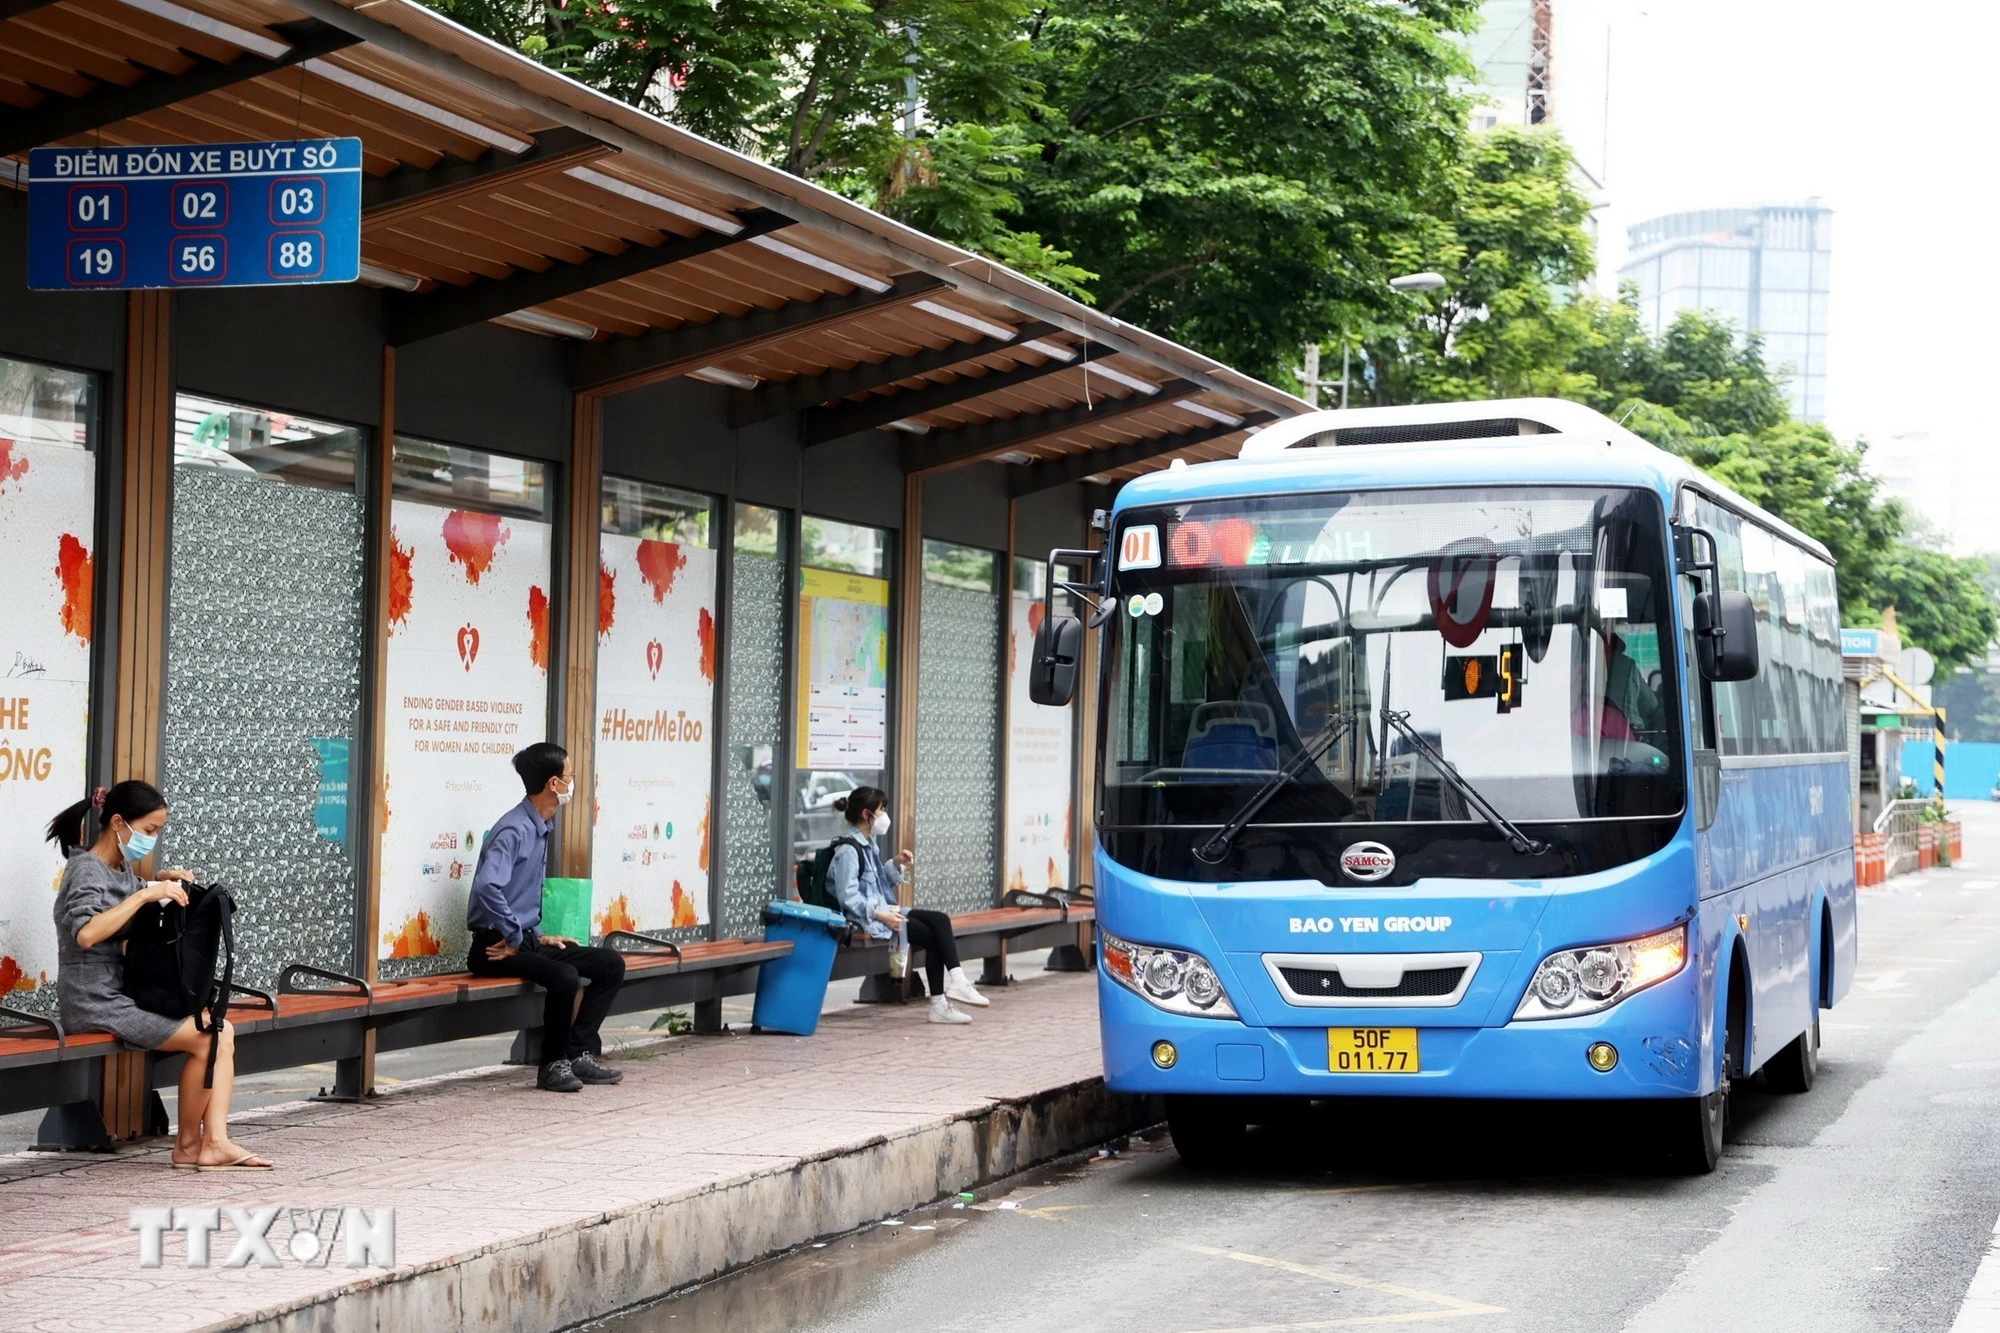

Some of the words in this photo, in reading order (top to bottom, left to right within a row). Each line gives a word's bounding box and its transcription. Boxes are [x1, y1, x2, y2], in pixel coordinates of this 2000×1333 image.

[55, 151, 118, 176] ĐIỂM
[125, 147, 182, 174] ĐÓN
[189, 151, 221, 173] XE
[230, 143, 296, 171] BUÝT
[303, 141, 338, 168] SỐ
[78, 195, 111, 221] 01
[182, 192, 217, 218] 02
[281, 188, 314, 214] 03
[79, 248, 113, 274] 19
[181, 246, 215, 272] 56
[280, 241, 313, 268] 88
[1125, 531, 1151, 564] 01
[403, 696, 433, 710] ENDING
[435, 699, 465, 712] GENDER
[466, 700, 489, 713] BASED
[489, 701, 523, 715] VIOLENCE
[409, 718, 424, 731] FOR
[425, 719, 432, 731] A
[433, 719, 451, 732] SAFE
[453, 721, 469, 733] AND
[471, 721, 503, 734] FRIENDLY
[504, 722, 520, 735] CITY
[601, 708, 703, 743] #HearMeToo
[414, 740, 430, 752] FOR
[432, 741, 462, 753] WOMEN
[463, 742, 480, 754] AND
[481, 742, 515, 755] CHILDREN
[1345, 855, 1391, 867] SAMCO
[1289, 917, 1334, 933] BAO
[1338, 917, 1379, 933] YEN
[1383, 916, 1452, 933] GROUP
[1353, 1030, 1391, 1049] 50F
[1338, 1051, 1408, 1070] 011.77
